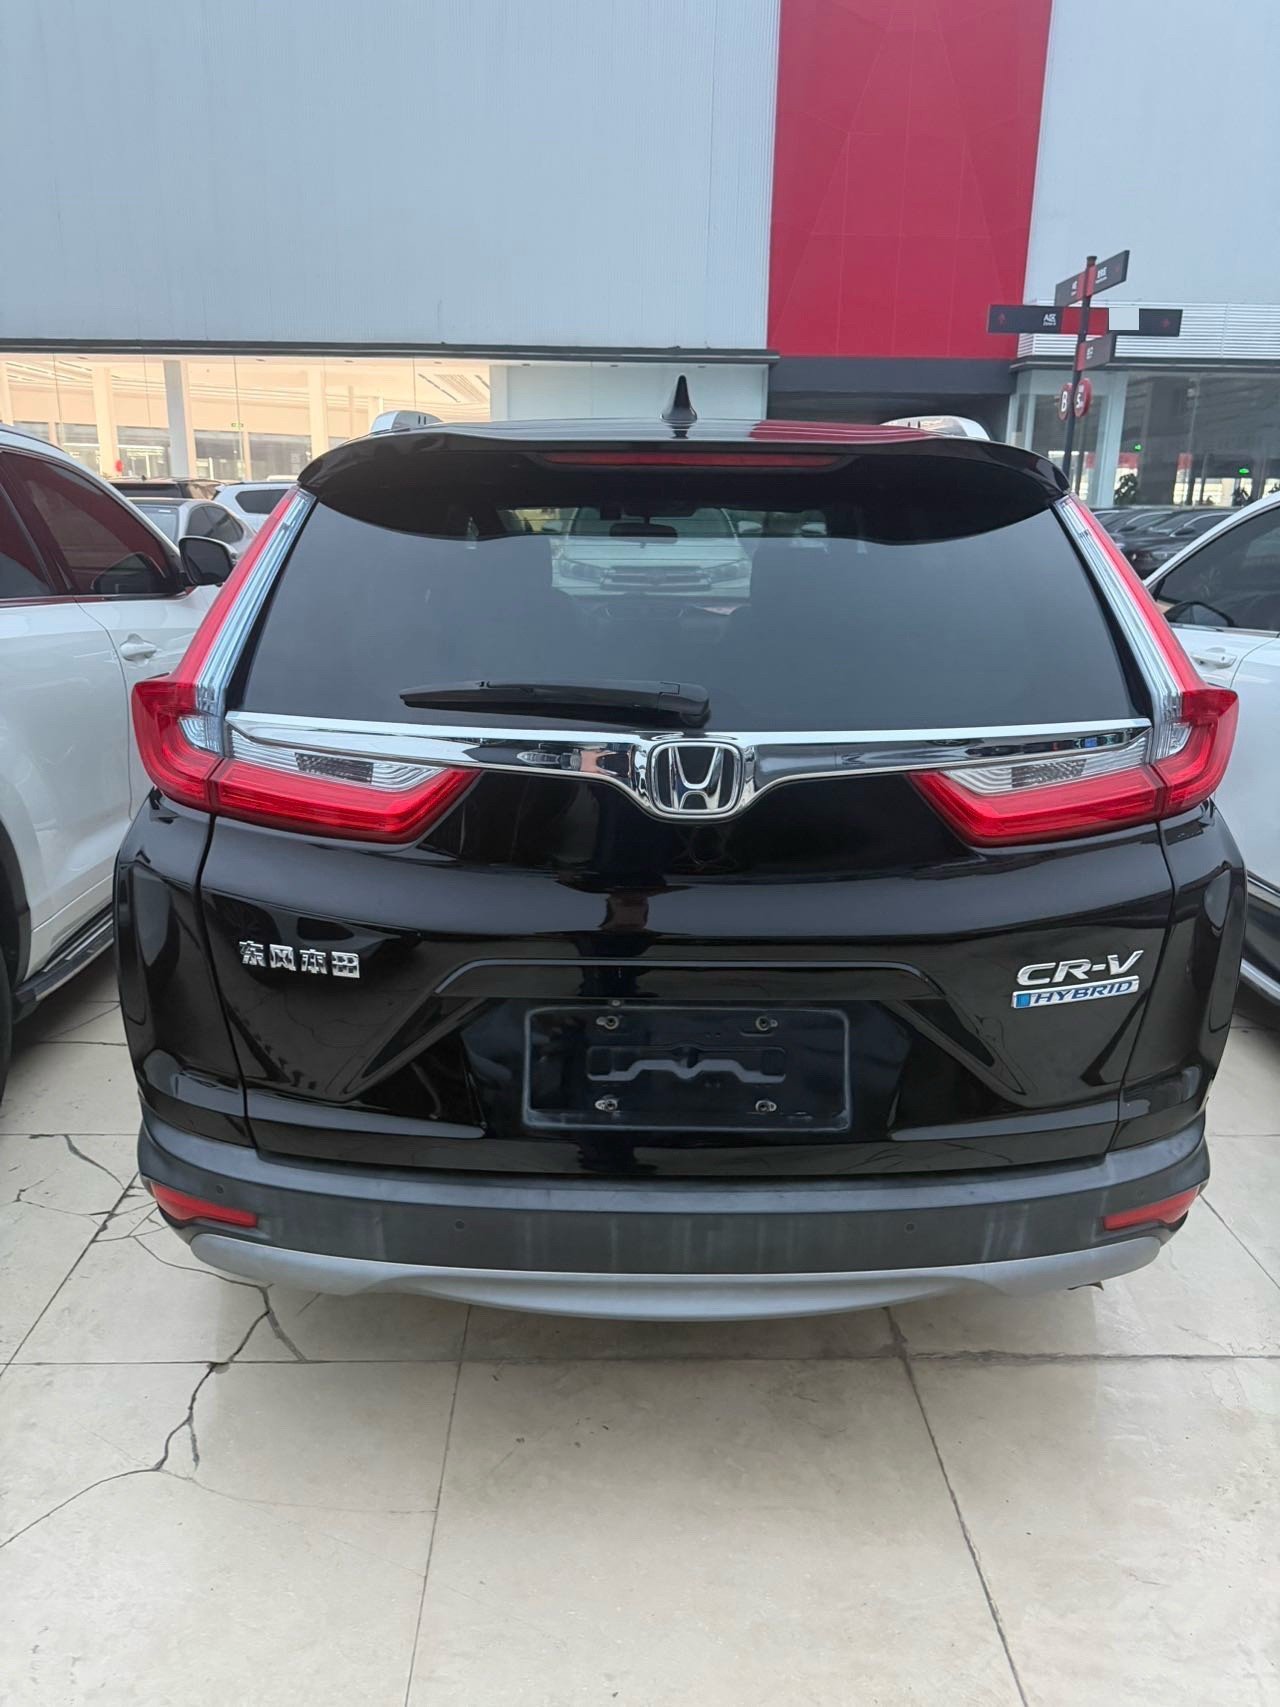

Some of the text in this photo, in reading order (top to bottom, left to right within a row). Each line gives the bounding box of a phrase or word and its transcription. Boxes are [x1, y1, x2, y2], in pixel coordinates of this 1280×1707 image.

[239, 940, 360, 979] 东风本田
[1016, 949, 1144, 986] CR-V
[1034, 980, 1133, 1004] HYBRID
